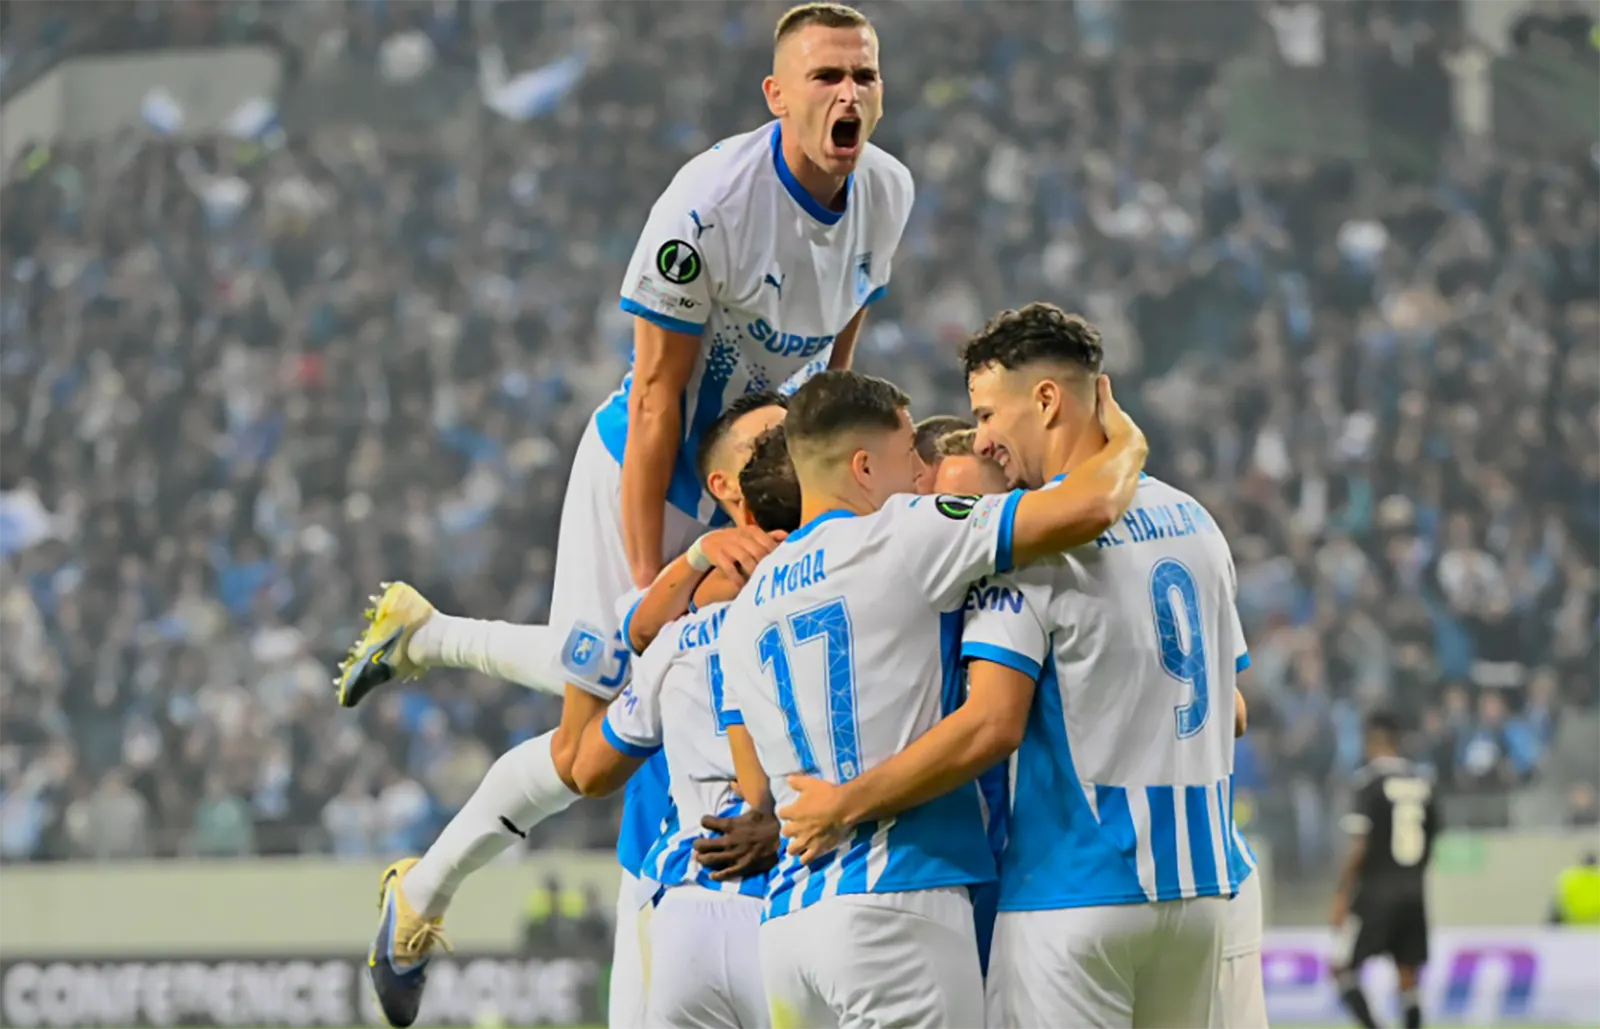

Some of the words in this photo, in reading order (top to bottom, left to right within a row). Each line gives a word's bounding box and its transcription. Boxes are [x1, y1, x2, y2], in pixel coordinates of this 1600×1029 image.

[747, 318, 835, 357] SUPER
[771, 548, 828, 599] MORA
[754, 595, 866, 786] 17
[1149, 556, 1210, 740] 9
